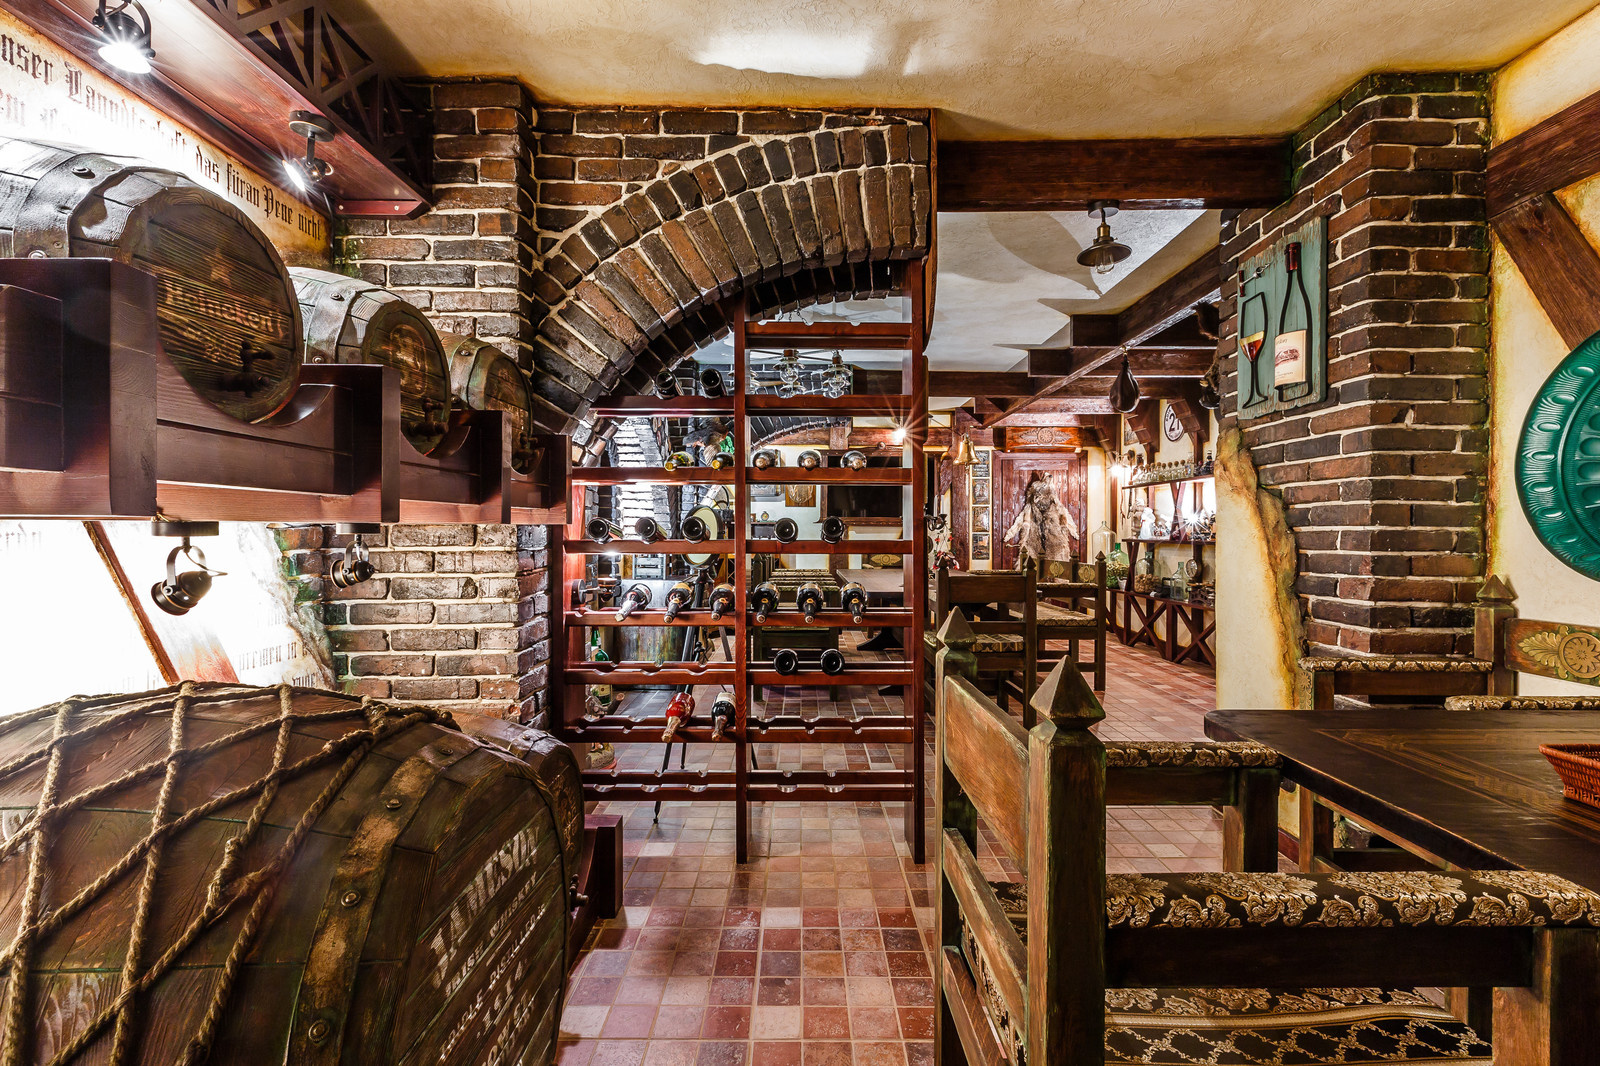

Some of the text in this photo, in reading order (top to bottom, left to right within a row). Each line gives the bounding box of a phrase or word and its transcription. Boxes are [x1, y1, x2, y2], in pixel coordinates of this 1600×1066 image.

[195, 144, 220, 184] das
[297, 211, 322, 241] nicht
[163, 282, 275, 334] Heineken
[431, 826, 539, 989] JAMESON
[444, 869, 537, 1000] IRISH WHISKEY
[439, 987, 484, 1063] TRIPLE
[488, 911, 536, 993] DISTILLED
[482, 1017, 511, 1066] OW
